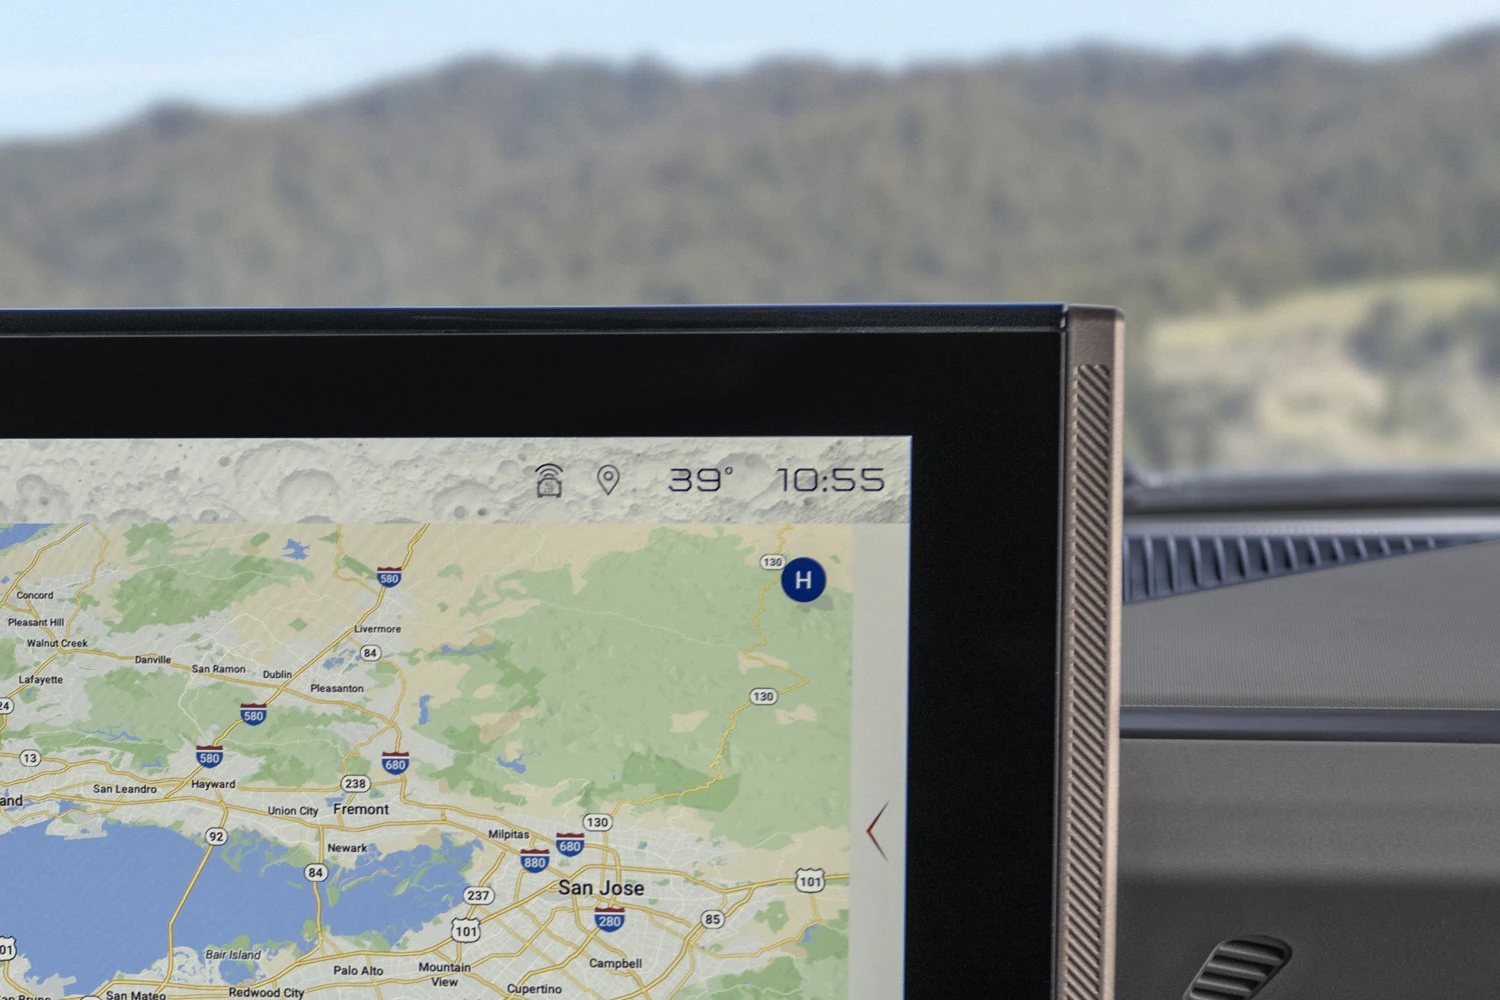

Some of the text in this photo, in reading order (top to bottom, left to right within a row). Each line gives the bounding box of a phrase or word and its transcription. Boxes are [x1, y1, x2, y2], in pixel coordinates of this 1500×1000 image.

[669, 467, 733, 492] 39°
[777, 468, 885, 492] 10:55
[764, 558, 782, 567] 130
[381, 574, 398, 584] 580
[796, 572, 811, 590] H
[17, 590, 53, 600] Concord
[8, 618, 65, 627] Pleasant Hill
[355, 625, 401, 634] Livermore
[27, 639, 88, 648] Walnut Creek
[364, 648, 377, 658] 84
[135, 655, 171, 664] Danville
[192, 664, 246, 673] San Ramon
[263, 670, 292, 679] Dublin
[19, 675, 63, 686] Lafayette
[311, 684, 364, 694] Pleasanton
[754, 692, 773, 702] 130
[245, 711, 263, 721] 580
[24, 754, 36, 763] 13
[200, 753, 219, 763] 580
[386, 760, 405, 770] 680
[192, 780, 235, 790] Hayward
[345, 779, 366, 789] 238
[93, 785, 157, 794] San Leandro
[268, 806, 319, 818] Union City
[334, 804, 389, 815] Fremont
[588, 818, 608, 828] 130
[210, 832, 223, 841] 92
[489, 830, 529, 841] Milpitas
[328, 844, 367, 853] Newark
[560, 842, 580, 851] 680
[524, 858, 545, 868] 880
[309, 868, 322, 878] 84
[800, 877, 821, 887] 101
[558, 880, 645, 896] San Jose
[468, 891, 489, 901] 237
[600, 916, 620, 926] 280
[705, 915, 720, 925] 85
[456, 927, 477, 937] 101
[206, 950, 261, 960] Bair Island
[419, 963, 471, 973] Mountain
[590, 959, 642, 970] Campbell
[334, 966, 383, 976] Palo Alto
[432, 977, 458, 987] View
[229, 988, 305, 1000] Redwood City
[507, 984, 562, 996] Cupertino
[107, 991, 166, 1000] San Mateo
